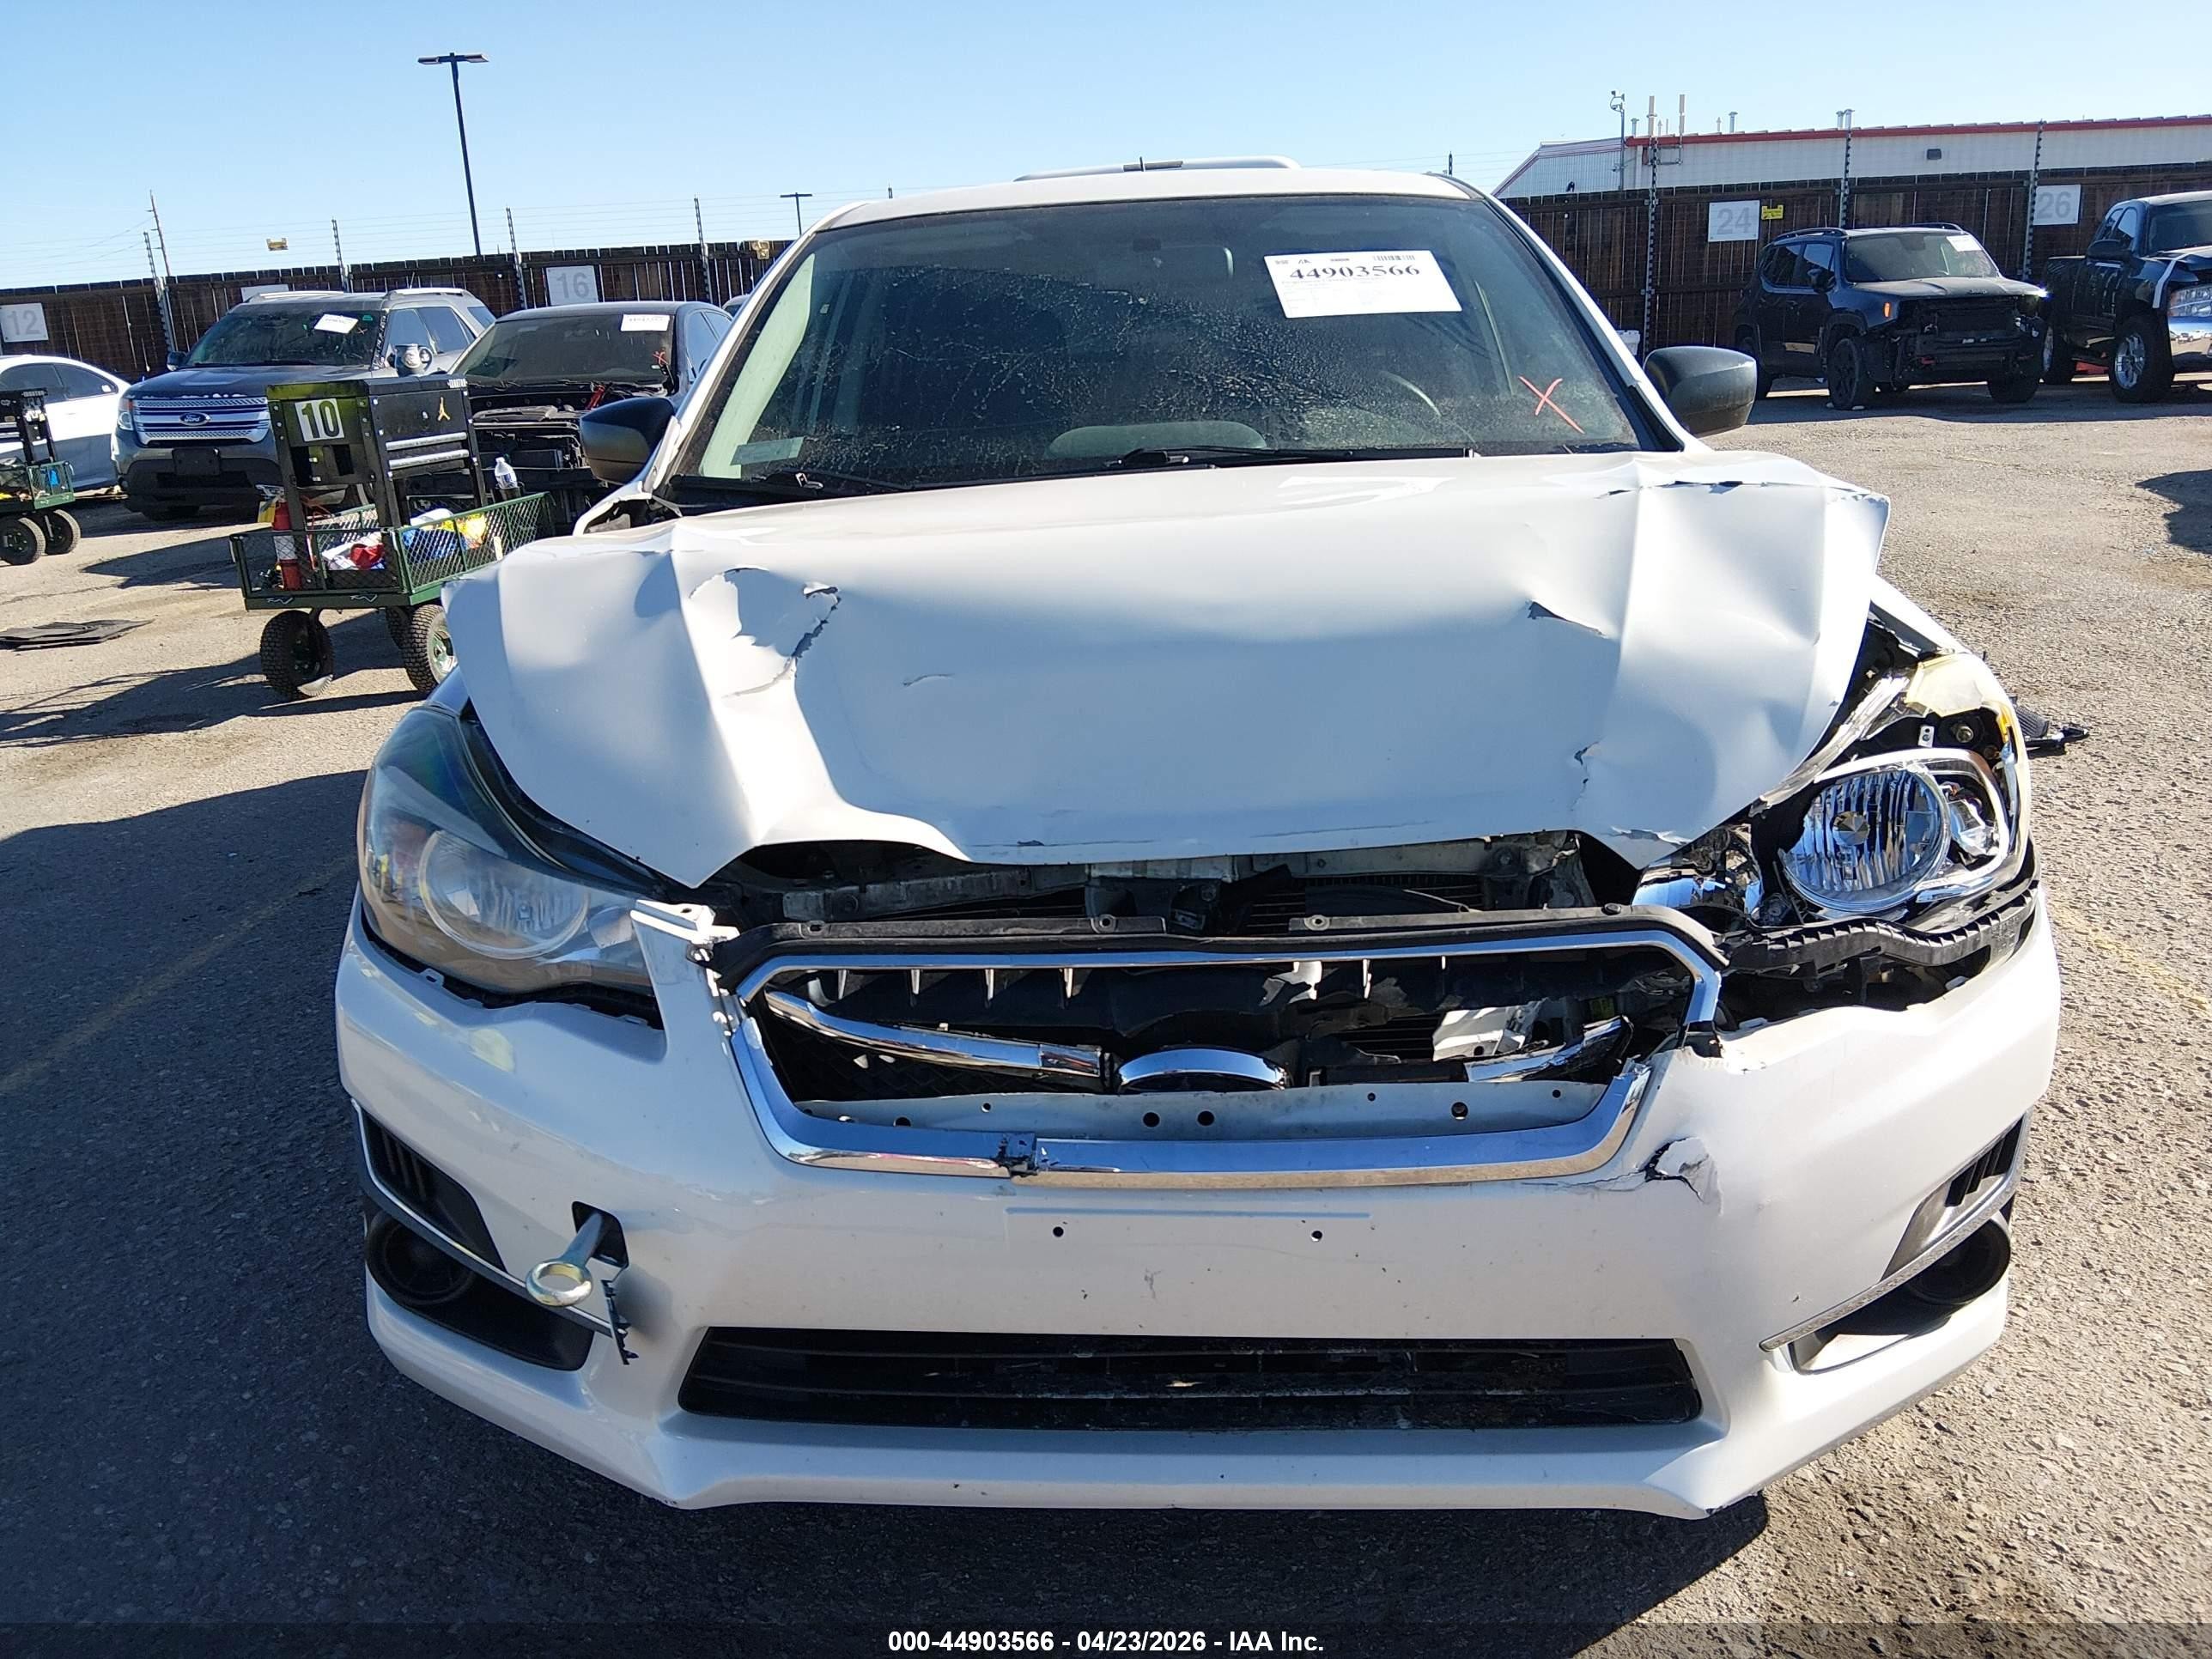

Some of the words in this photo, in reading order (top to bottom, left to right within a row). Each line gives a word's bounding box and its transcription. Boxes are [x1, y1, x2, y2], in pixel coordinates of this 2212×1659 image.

[2036, 191, 2071, 218] 26
[1717, 207, 1752, 235] 24
[556, 271, 590, 299] 16
[1289, 264, 1420, 279] 44903566
[7, 309, 42, 336] 12
[301, 399, 340, 439] 10
